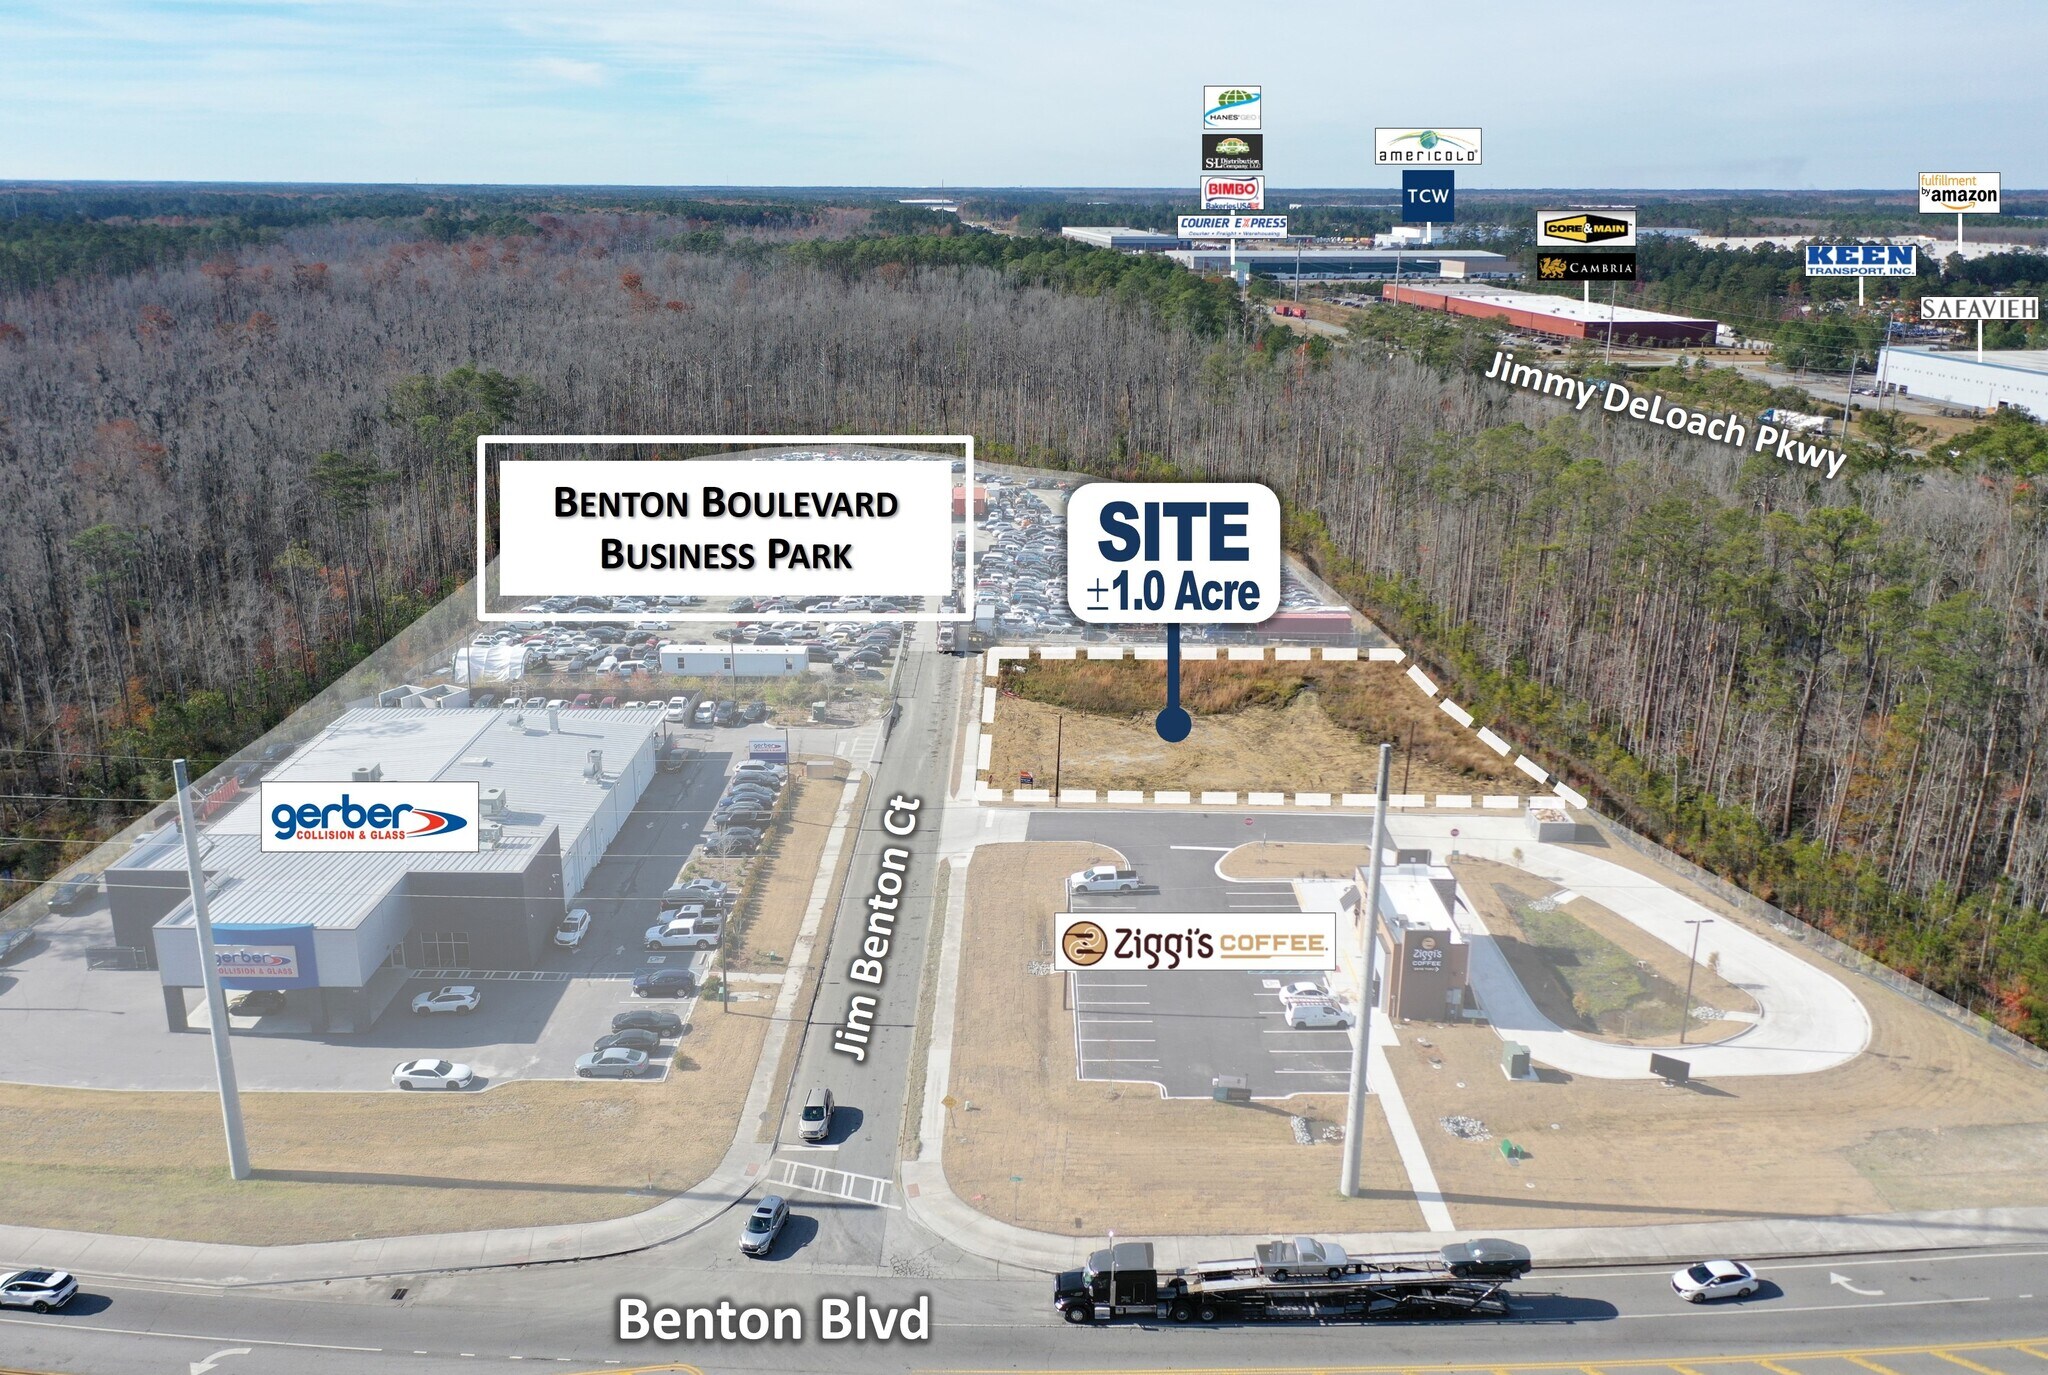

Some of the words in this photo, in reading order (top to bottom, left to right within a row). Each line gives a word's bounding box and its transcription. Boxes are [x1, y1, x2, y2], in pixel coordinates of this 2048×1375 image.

[1412, 948, 1443, 961] Ziggi's
[216, 966, 256, 976] OLLISION
[266, 967, 294, 976] GLASS
